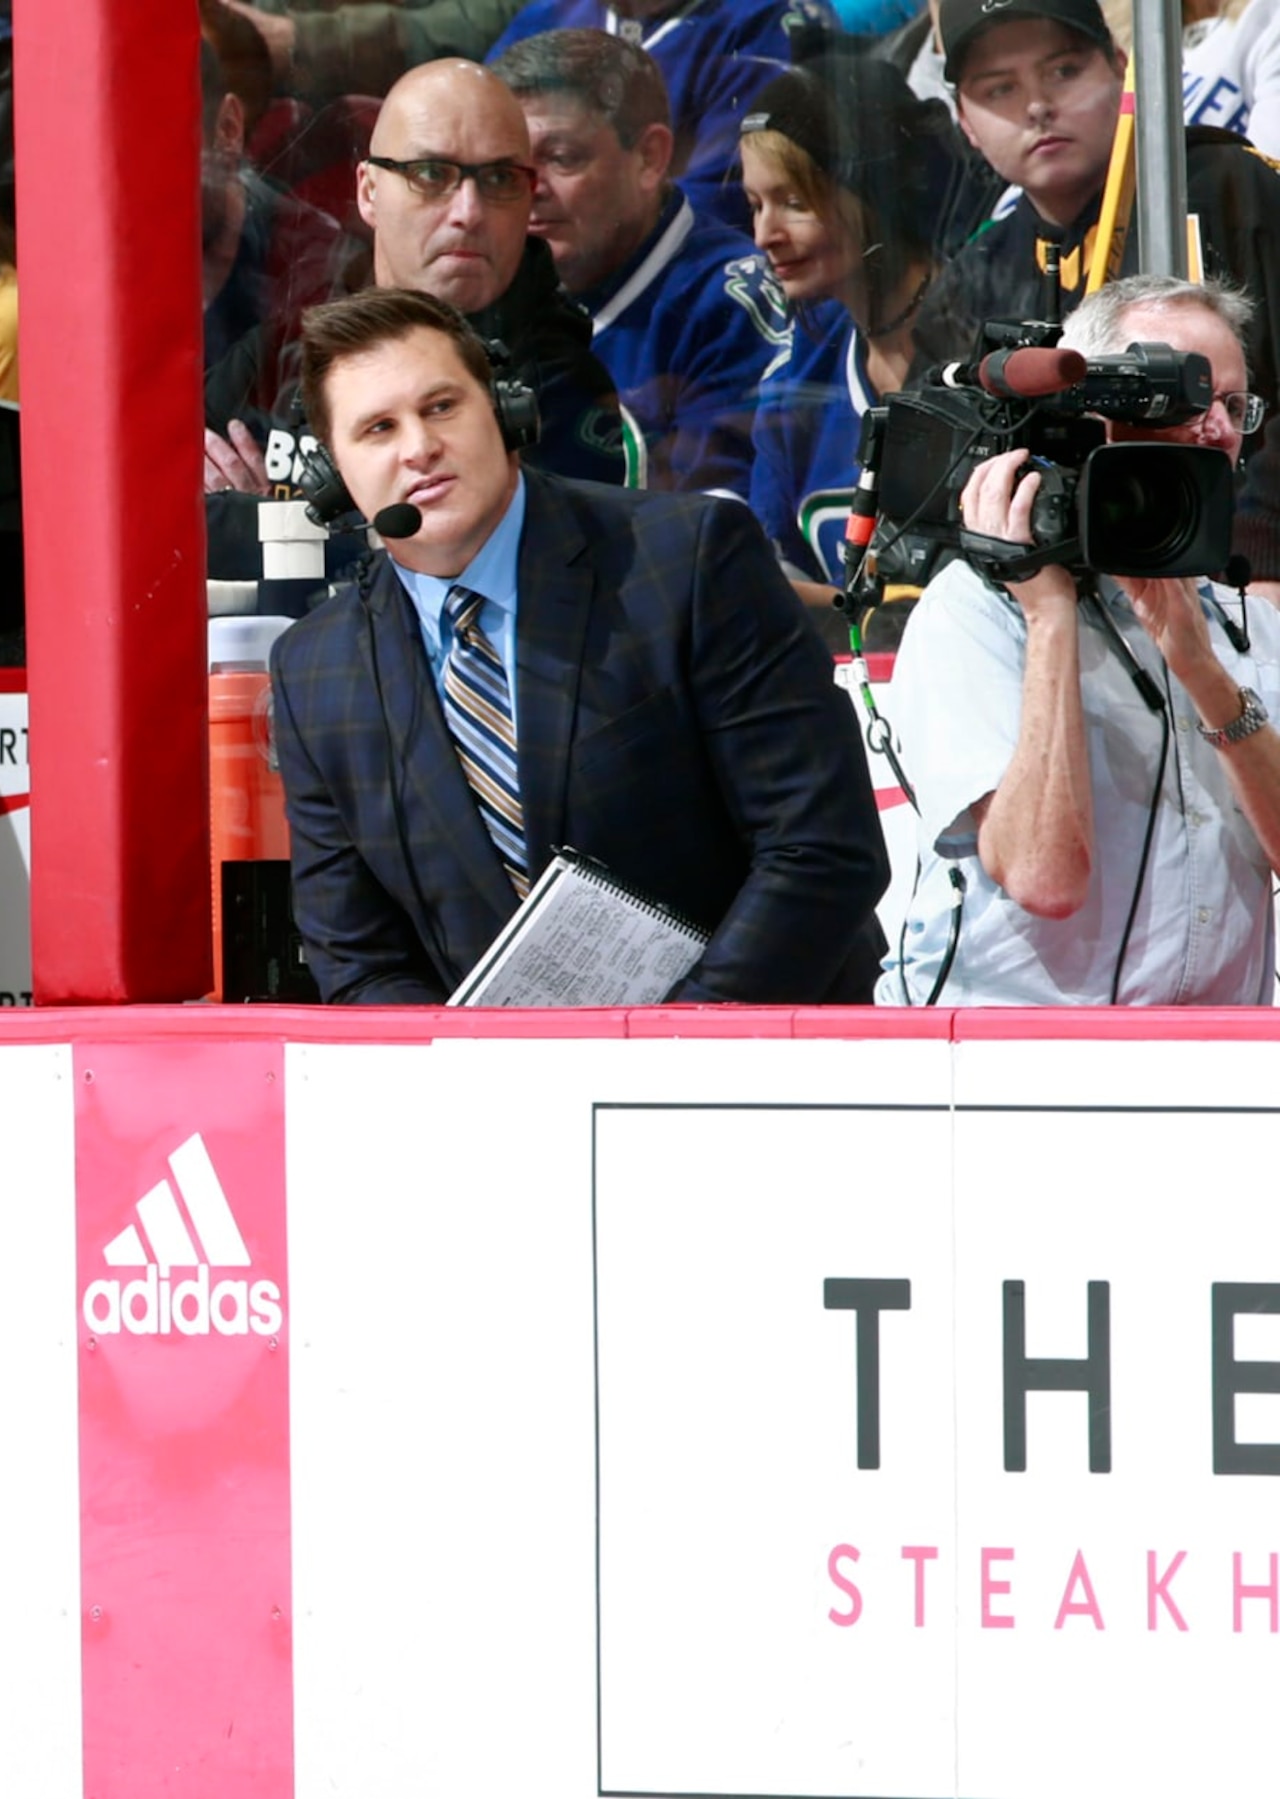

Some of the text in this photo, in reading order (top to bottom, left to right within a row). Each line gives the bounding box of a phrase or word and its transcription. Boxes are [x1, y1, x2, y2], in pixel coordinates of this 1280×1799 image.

[82, 1263, 283, 1336] adidas
[823, 1277, 1280, 1477] THE
[827, 1542, 1279, 1634] STEAKH
